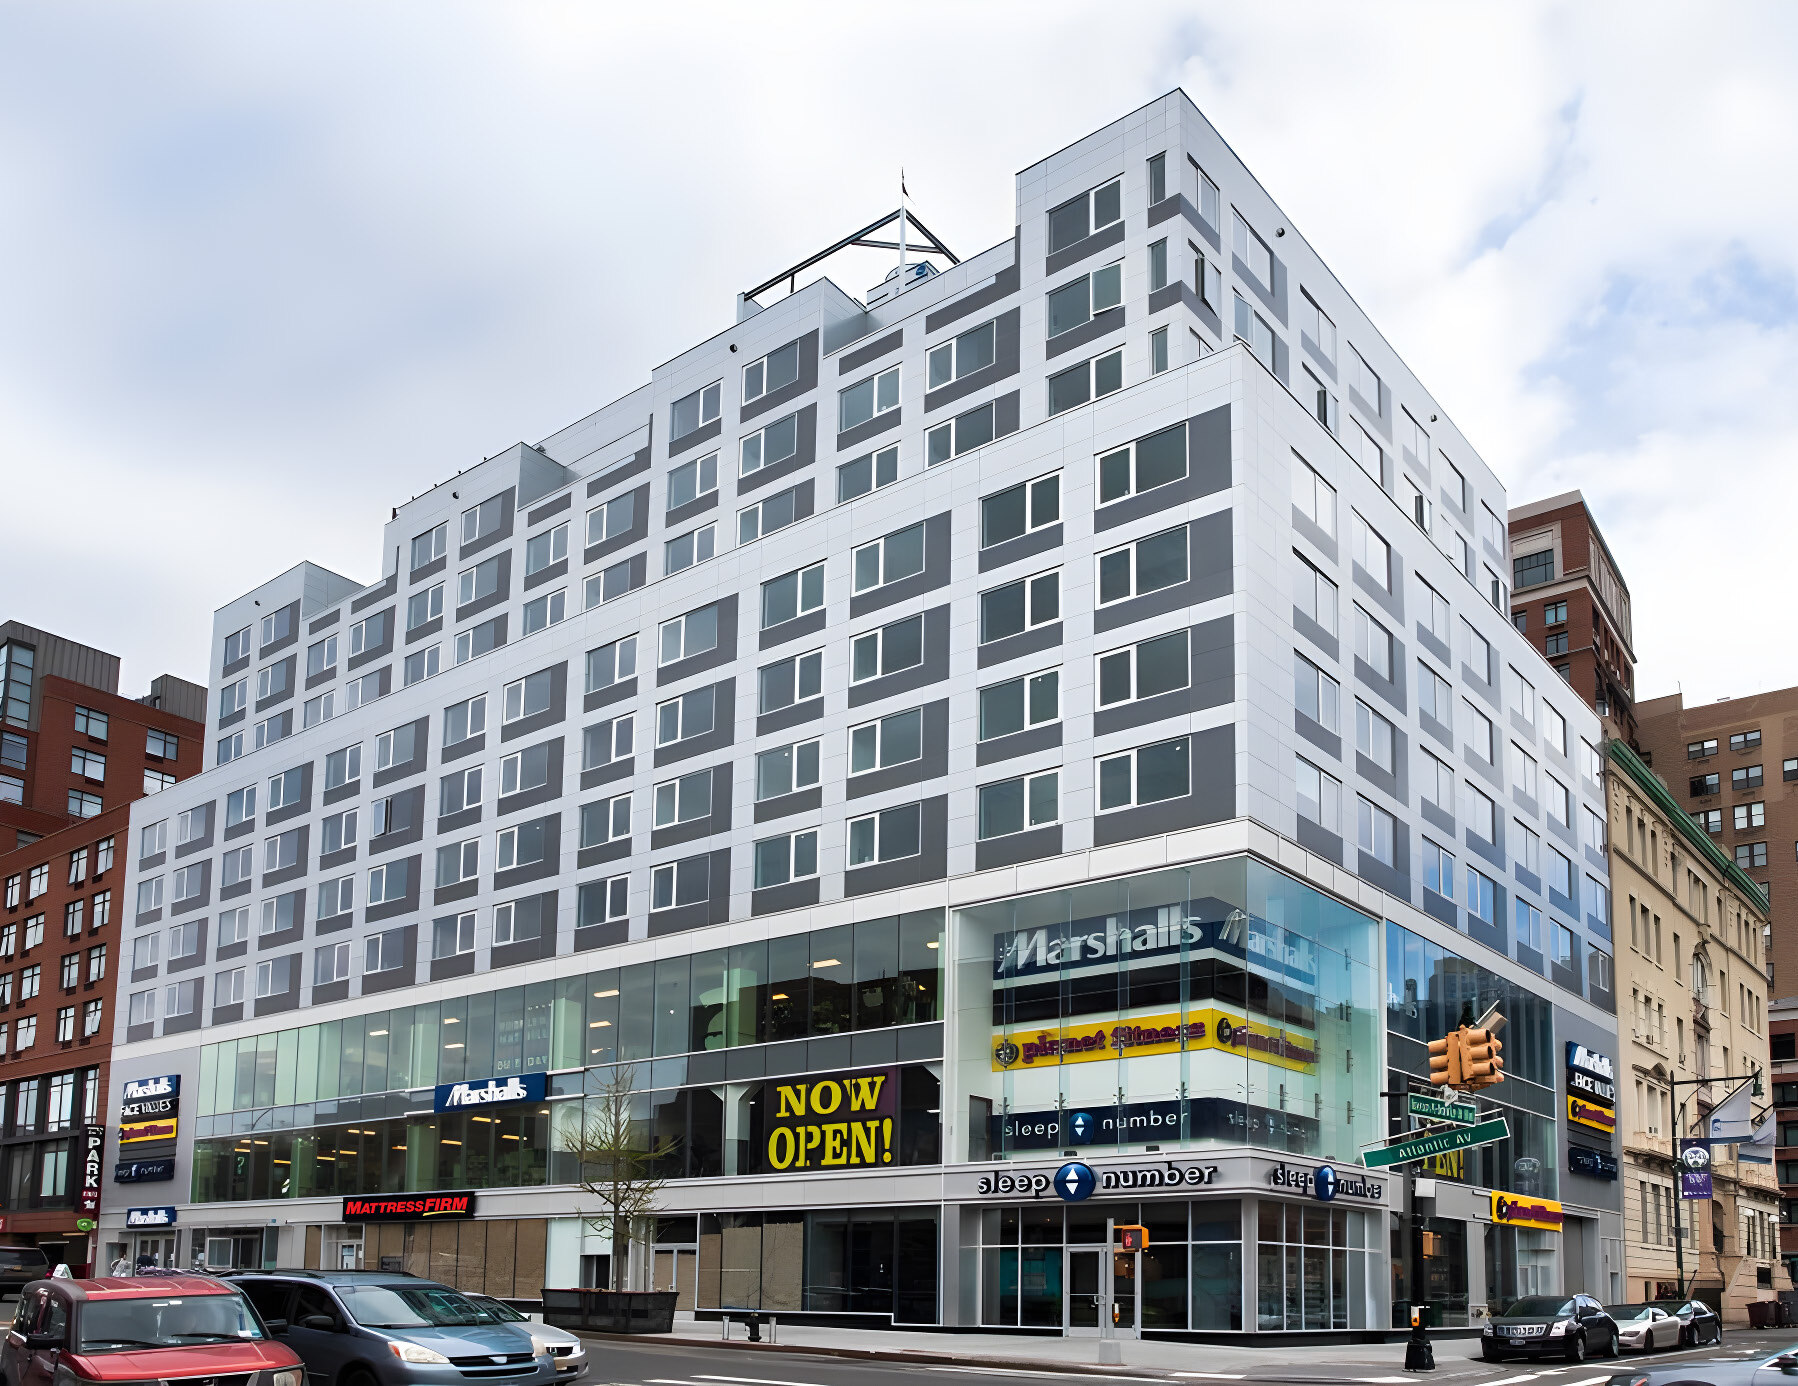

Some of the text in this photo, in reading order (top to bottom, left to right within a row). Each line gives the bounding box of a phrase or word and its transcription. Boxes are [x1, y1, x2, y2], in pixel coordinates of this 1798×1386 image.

[997, 905, 1203, 973] Marshalls
[445, 1077, 527, 1107] Marshalls
[776, 1075, 886, 1118] NOW
[768, 1117, 893, 1170] OPEN!
[1005, 1110, 1188, 1138] sleep number
[85, 1136, 101, 1188] PARK
[1399, 1137, 1450, 1158] Atlantic
[978, 1161, 1218, 1199] sleep number
